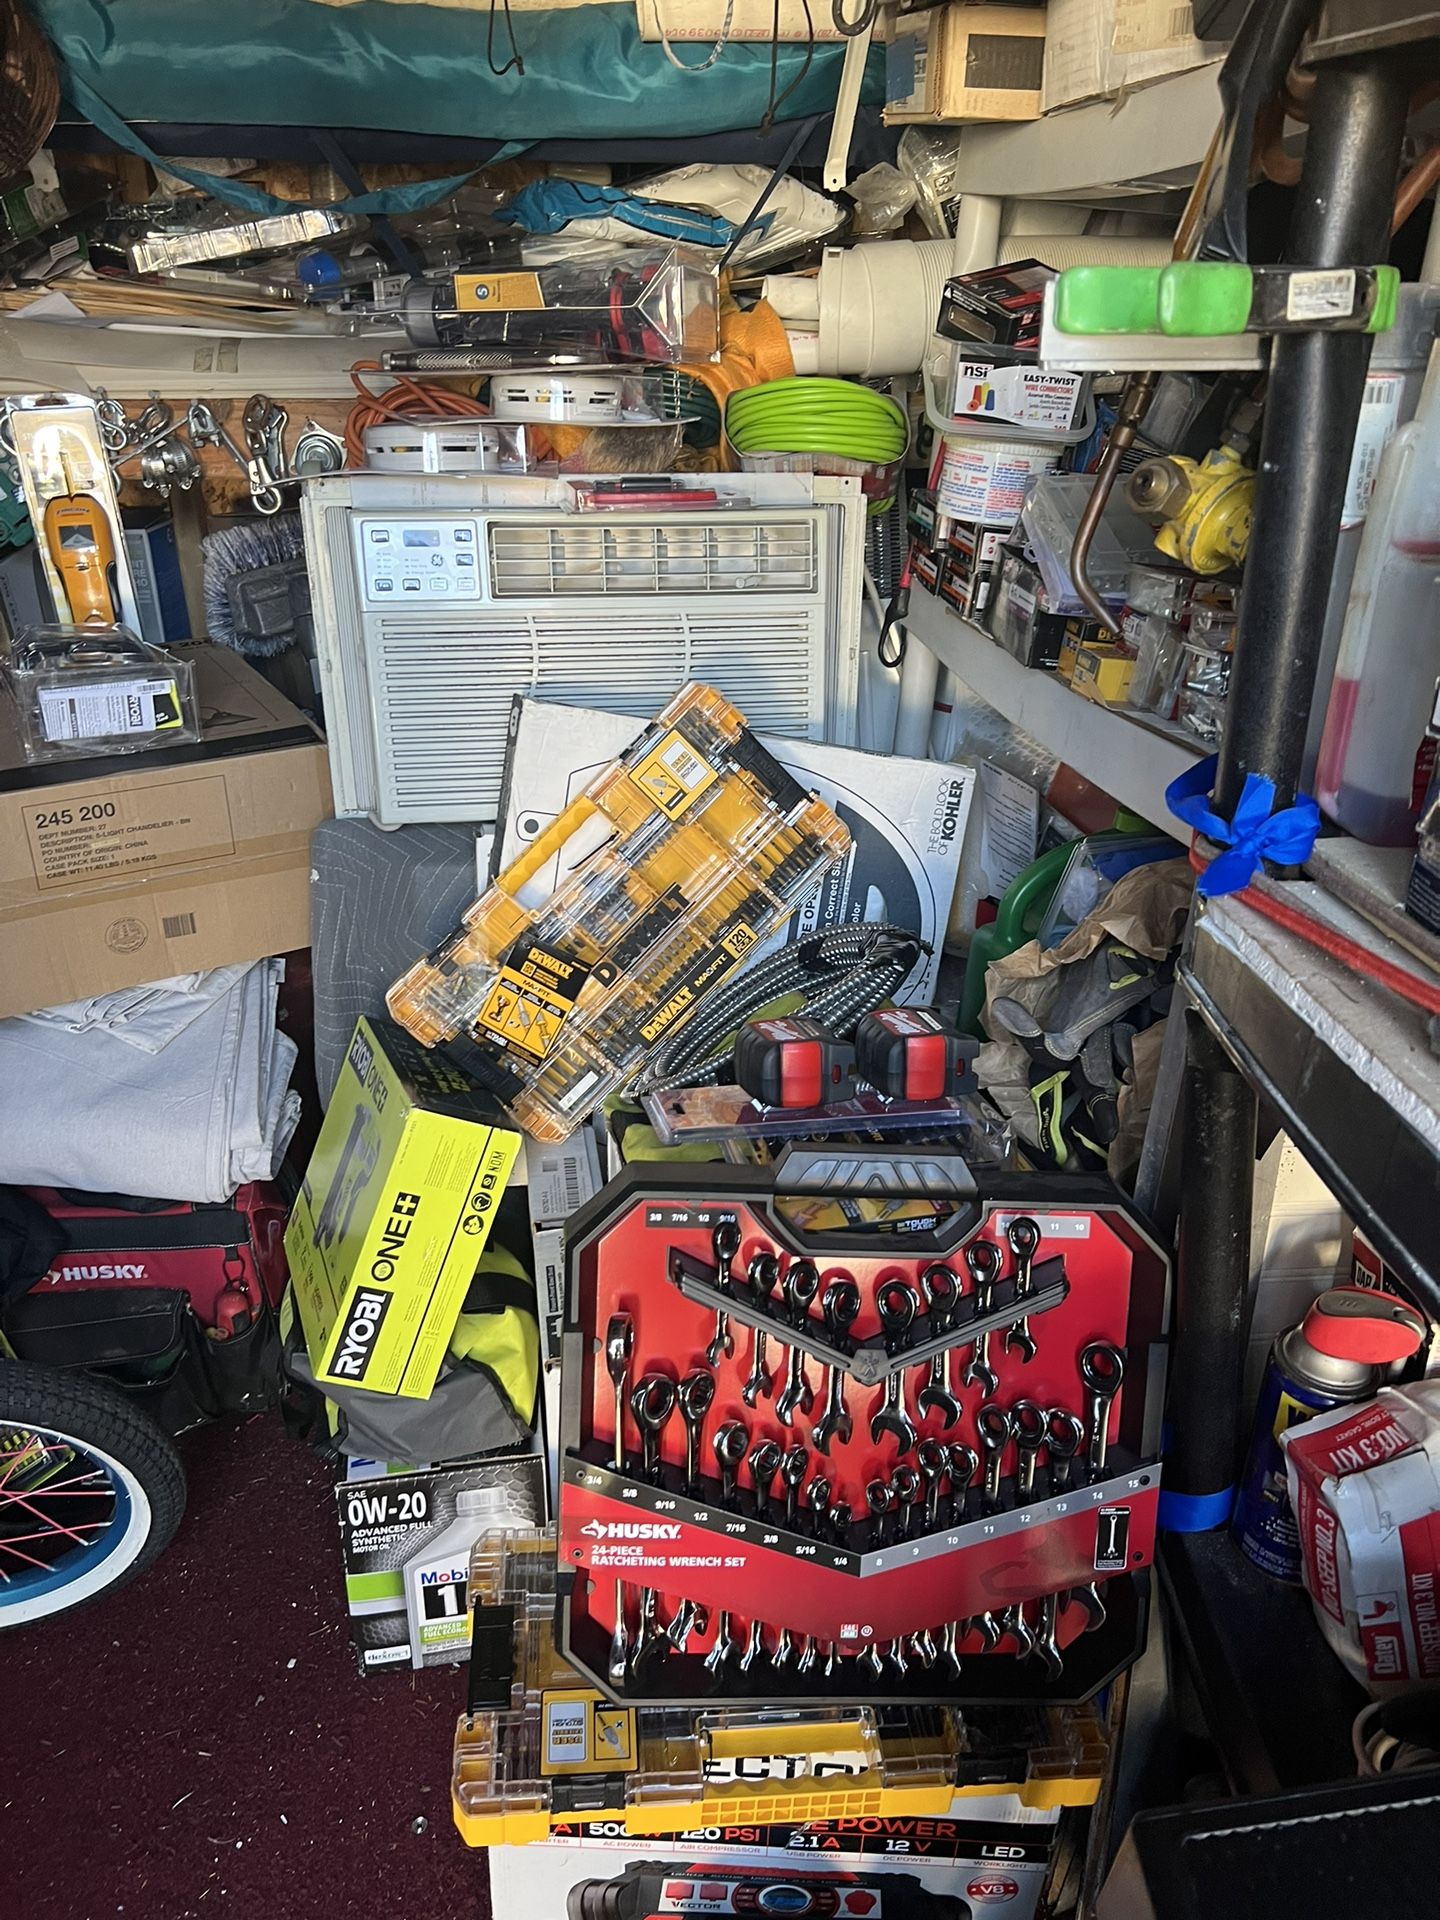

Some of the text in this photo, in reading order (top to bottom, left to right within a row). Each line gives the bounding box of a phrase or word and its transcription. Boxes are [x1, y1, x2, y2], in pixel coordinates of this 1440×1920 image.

[964, 365, 989, 378] nsi
[1023, 374, 1076, 386] EASY-TWIST
[1040, 385, 1073, 395] CONNECTORS
[35, 802, 116, 829] 245 200
[927, 777, 951, 853] THE BOLD LOOK
[39, 823, 107, 841] DEPT NUMBER: 27
[40, 833, 95, 849] DESCRIPTION:
[126, 819, 174, 834] CHANDELIER
[41, 848, 54, 857] PO
[43, 839, 149, 865] COUNTRY OF ORIGIN: CHINA
[937, 841, 949, 856] OF
[45, 863, 67, 872] CASE
[67, 858, 88, 869] PACK
[90, 855, 109, 865] SIZE:
[46, 870, 68, 880] CASE
[141, 853, 157, 863] KGS
[825, 879, 839, 919] Correct
[851, 902, 862, 923] olor
[727, 928, 748, 947] 120
[639, 985, 696, 1043] DEWALT
[671, 1213, 688, 1222] 7/16
[904, 1217, 937, 1227] TOUGH
[1050, 1223, 1060, 1231] 11
[1075, 1223, 1085, 1232] 10
[62, 1264, 146, 1282] HUSKY
[333, 1292, 388, 1377] RYOBI
[1329, 1445, 1365, 1473] KIT
[587, 1474, 602, 1485] 3/4
[1128, 1479, 1140, 1489] 15
[347, 1489, 367, 1501] SAE
[622, 1488, 637, 1498] 5/8
[1092, 1491, 1103, 1501] 14
[347, 1491, 427, 1527] 0W-20
[655, 1500, 676, 1510] 9/16
[1056, 1502, 1067, 1512] 13
[693, 1512, 708, 1521] 1/2
[1020, 1513, 1031, 1523] 12
[351, 1519, 434, 1539] ADVANCED FULL
[607, 1523, 679, 1540] HUSKY
[726, 1523, 746, 1533] 7/16
[983, 1525, 995, 1535] 11
[351, 1533, 407, 1548] SYNTHETIC
[947, 1536, 959, 1545] 10
[352, 1543, 391, 1555] MOTOR OIL
[591, 1545, 643, 1556] 24-PIECE
[795, 1546, 816, 1555] 5/16
[912, 1547, 919, 1556] 9
[591, 1556, 746, 1568] RATCHETING WRENCH SET
[833, 1557, 848, 1566] 1/4
[876, 1558, 883, 1567] 8
[421, 1566, 469, 1586] Mobi
[1412, 1572, 1433, 1592] KIT
[437, 1584, 459, 1616] 1
[423, 1621, 462, 1632] ADVANCED
[423, 1624, 470, 1639] FUEL ECONO
[1375, 1636, 1395, 1674] Oatey
[553, 1823, 573, 1834] A
[838, 1816, 957, 1838] POWER
[680, 1827, 761, 1842] 120 PSI
[789, 1831, 841, 1849] 2.1 A
[617, 1841, 652, 1849] POWER
[680, 1843, 761, 1854] AIR COMPRESSOR
[885, 1839, 932, 1852] 12 V
[805, 1852, 841, 1860] POWER
[981, 1845, 1026, 1859] LED
[897, 1856, 932, 1864] POWER
[973, 1860, 1028, 1869] WORKLIGHT
[980, 1885, 1005, 1895] V8
[671, 1901, 721, 1910] VECTOR
